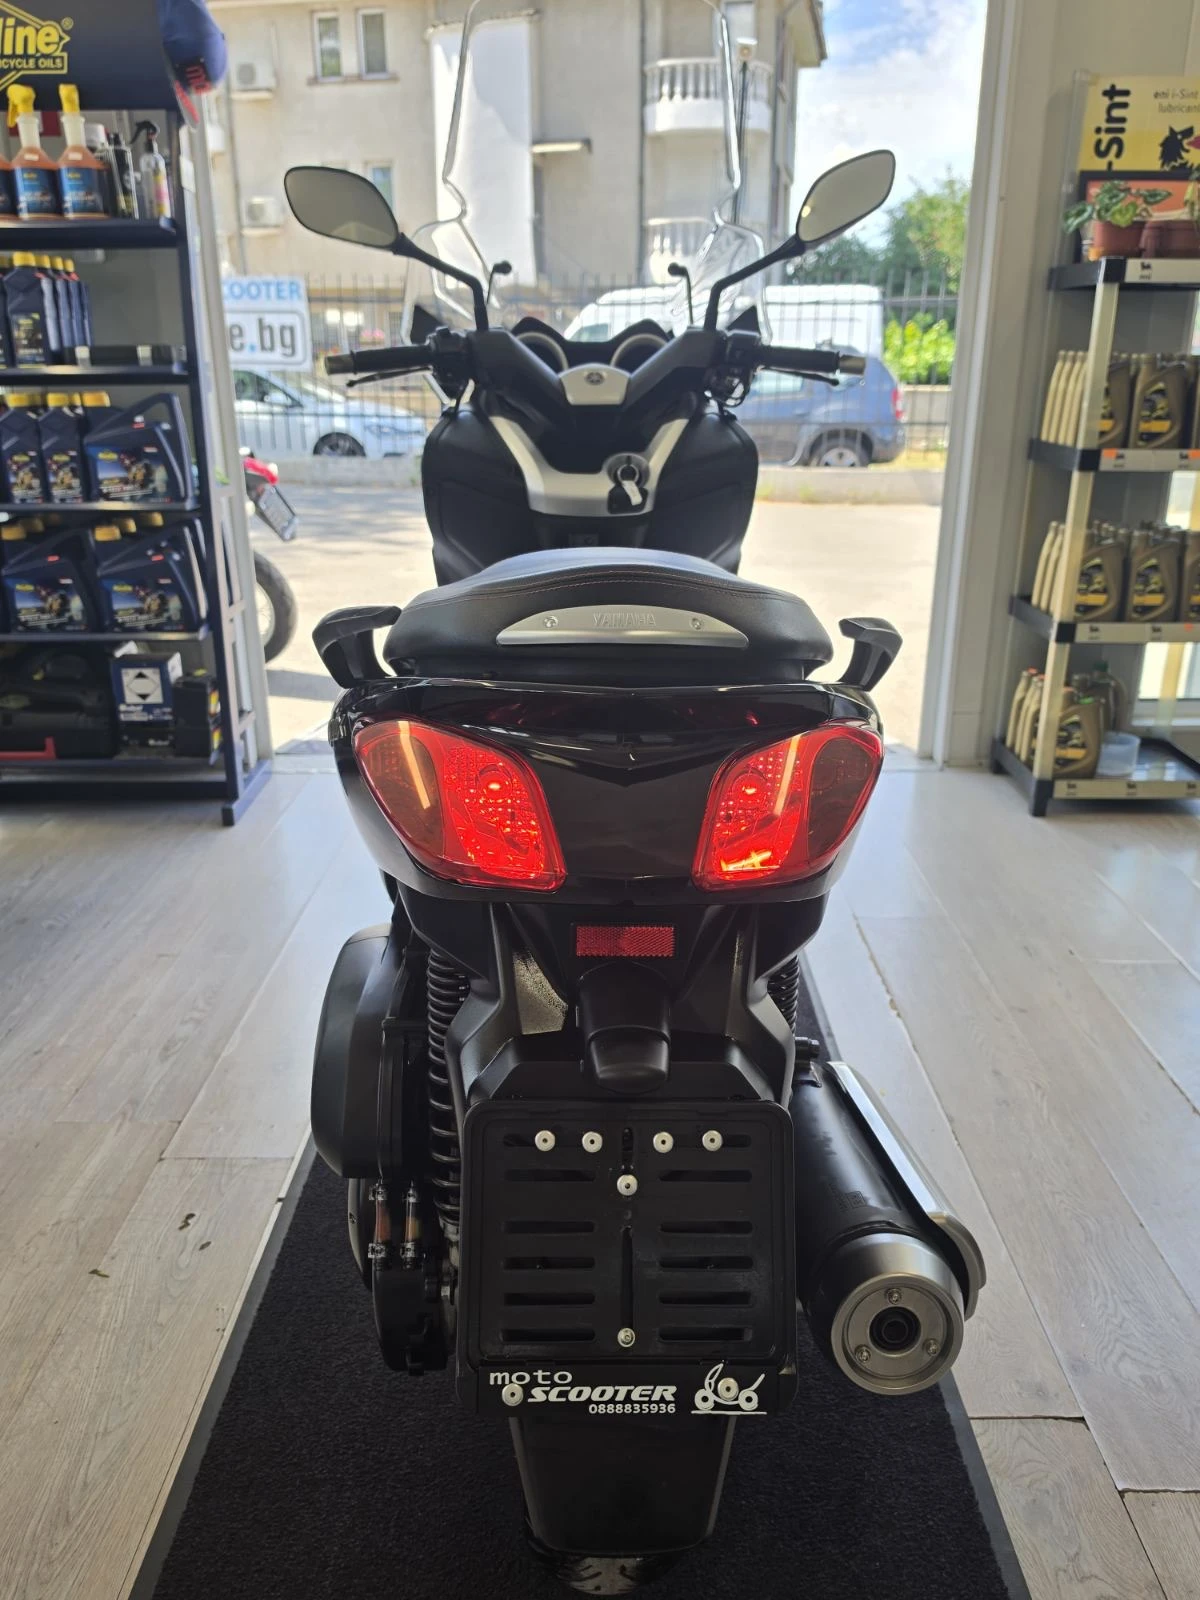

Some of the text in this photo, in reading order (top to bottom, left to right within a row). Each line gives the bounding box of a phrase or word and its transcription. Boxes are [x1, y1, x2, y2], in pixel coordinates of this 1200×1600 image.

[0, 58, 63, 69] CYCLE OILS
[593, 613, 656, 628] YAMAHA
[489, 1370, 573, 1385] moto
[528, 1385, 677, 1402] SCOOTER
[588, 1403, 676, 1414] 0888835936
